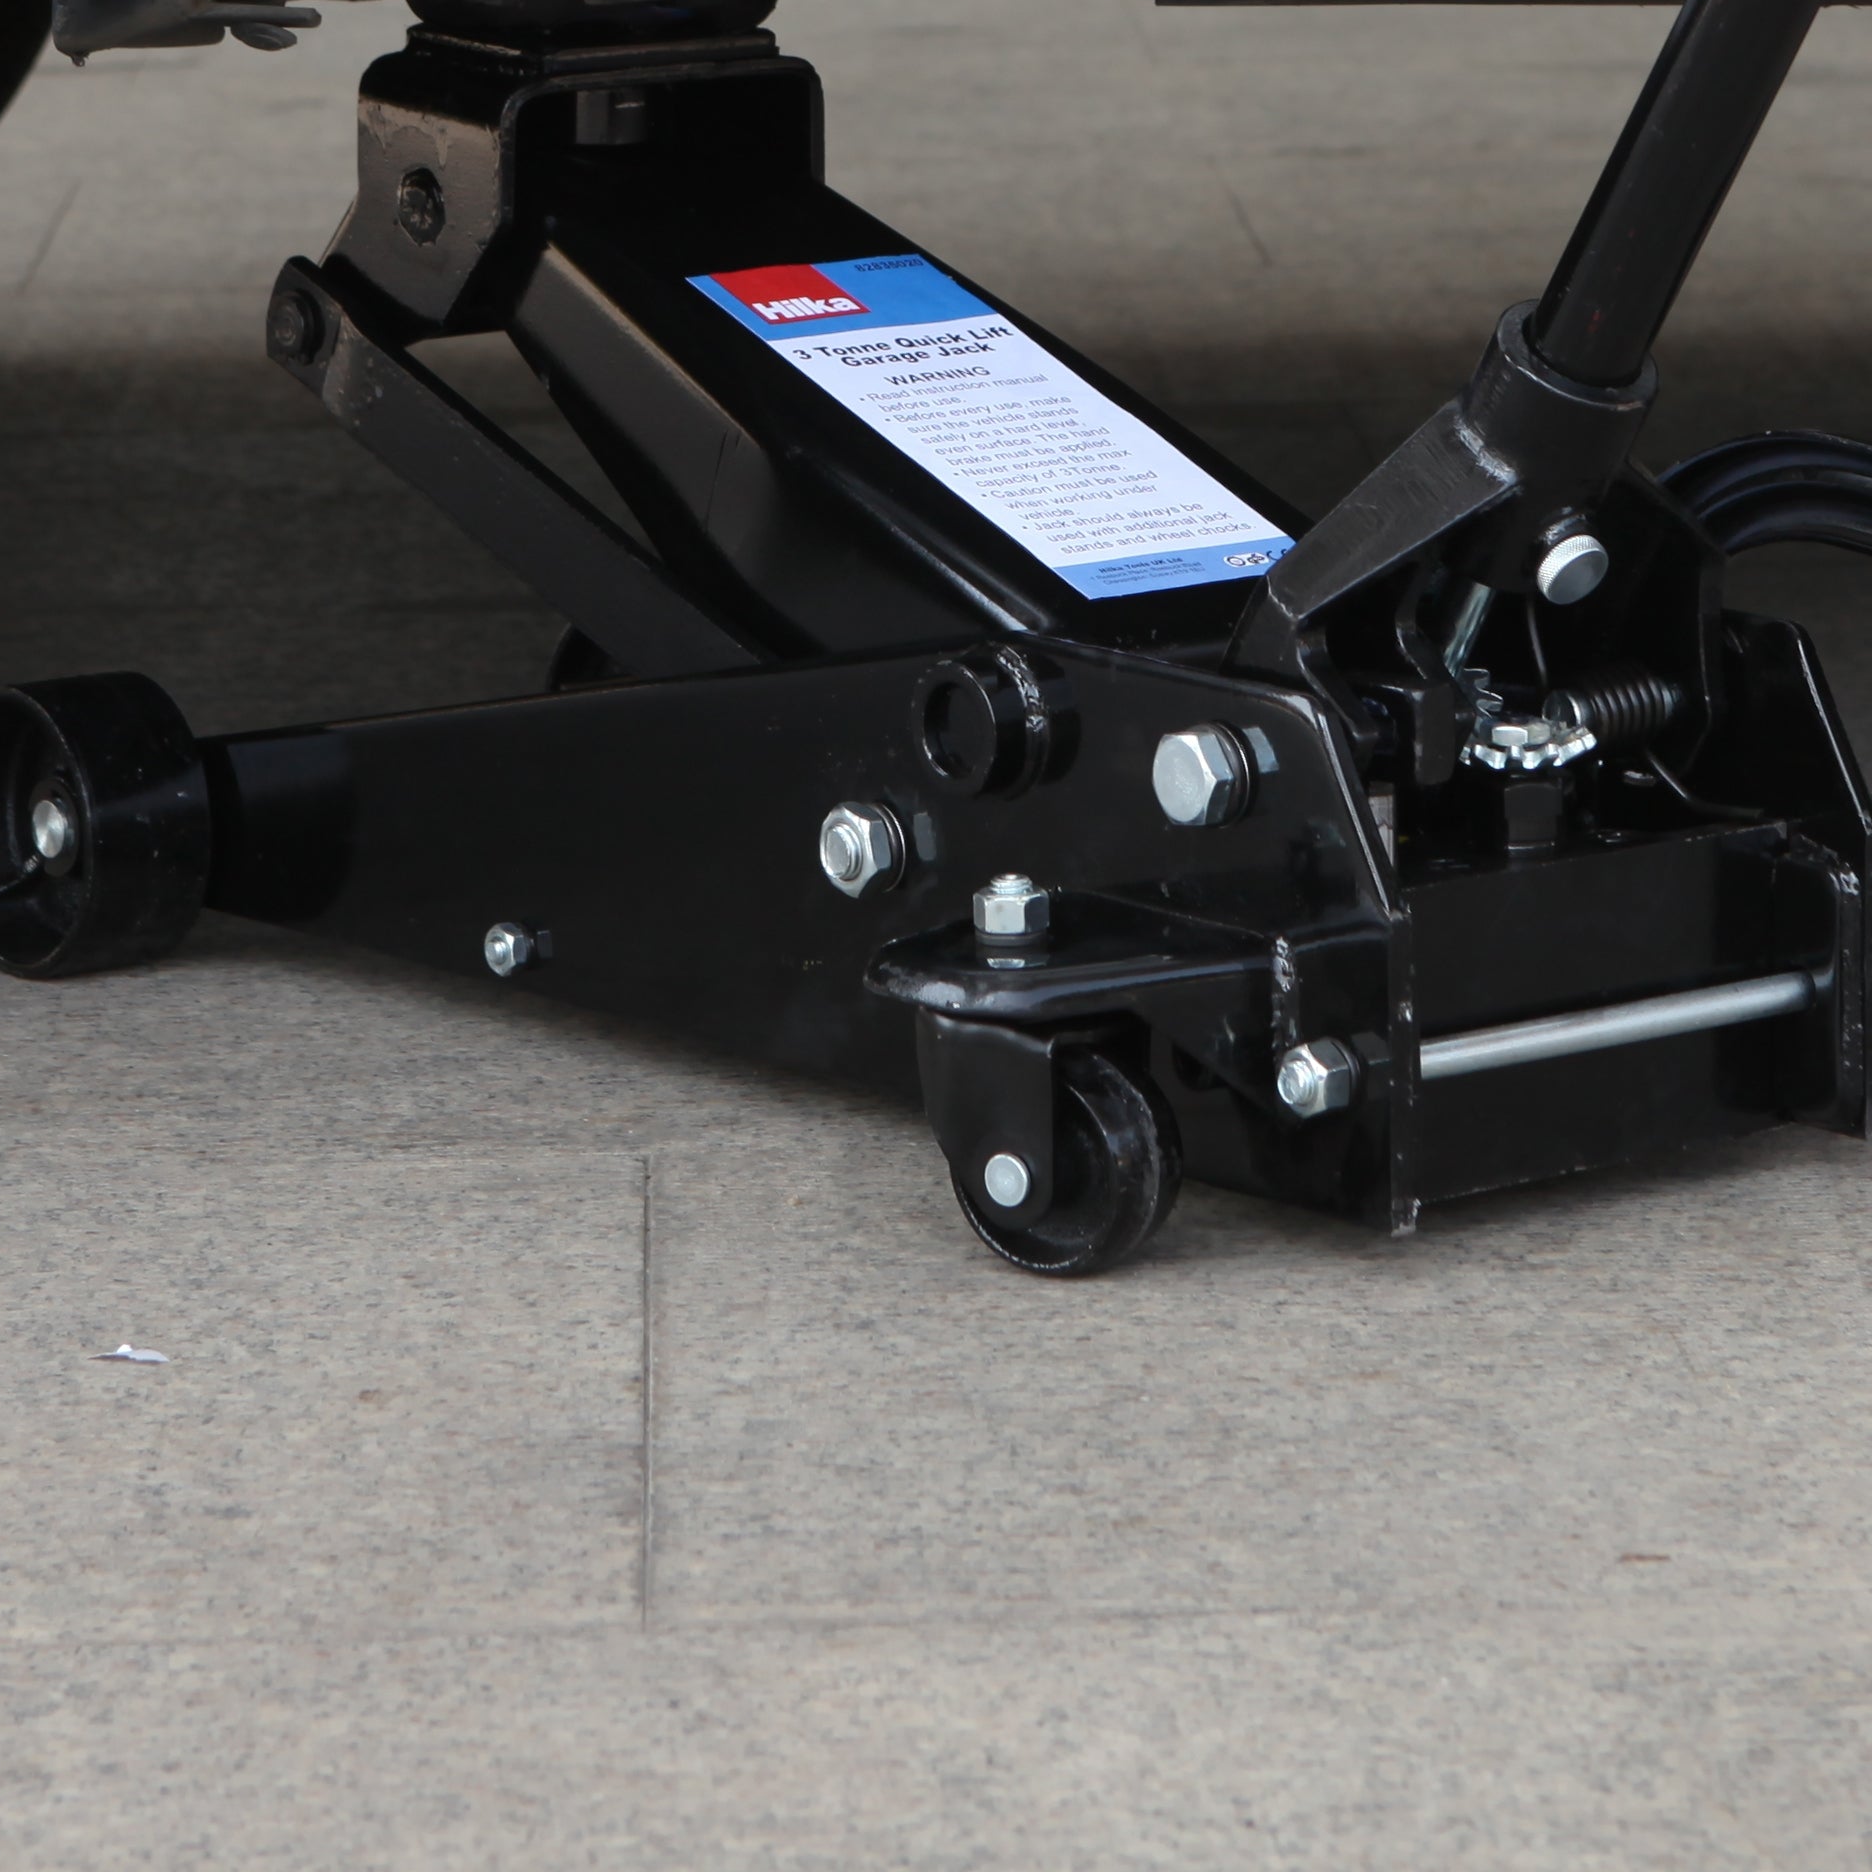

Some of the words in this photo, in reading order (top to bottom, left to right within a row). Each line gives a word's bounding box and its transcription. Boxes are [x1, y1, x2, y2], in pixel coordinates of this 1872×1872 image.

[751, 296, 861, 320] Hilka
[793, 349, 812, 359] 3
[812, 342, 891, 357] Tonne
[895, 333, 968, 348] Quick
[967, 327, 1014, 340] Lift
[841, 351, 930, 366] Garage
[938, 342, 996, 357] Jack
[866, 390, 911, 402] Read
[911, 381, 990, 396] instruction
[993, 373, 1048, 387] manual
[883, 366, 990, 386] WARNING
[878, 399, 930, 413] before
[932, 396, 966, 406] use.
[893, 411, 946, 423] Before
[949, 405, 992, 417] every
[1028, 396, 1072, 407] make
[907, 423, 942, 434] sure
[943, 420, 970, 429] the
[971, 413, 1026, 426] vehicle
[1028, 407, 1079, 420] stands
[921, 433, 966, 445] safely
[969, 430, 990, 439] on
[1003, 422, 1042, 435] hard
[935, 445, 973, 455] even
[975, 437, 1037, 450] surface.
[1035, 433, 1069, 442] The
[1068, 426, 1110, 438] hand
[945, 455, 992, 466] brake
[994, 449, 1033, 459] must
[1033, 447, 1056, 456] be
[1058, 438, 1116, 453] applied.
[960, 465, 1008, 477] Never
[1012, 456, 1068, 470] exceed
[1068, 454, 1095, 463] the
[1097, 449, 1132, 460] max
[975, 473, 1039, 488] capacity
[1041, 470, 1058, 479] of
[990, 486, 1052, 498] Caution
[1054, 478, 1094, 491] must
[1093, 477, 1117, 485] be
[1118, 470, 1158, 482] used
[1007, 499, 1050, 510] when
[1050, 489, 1113, 505] working
[1113, 484, 1158, 496] under
[1035, 520, 1070, 530] Jack
[1072, 512, 1124, 526] should
[1127, 507, 1180, 519] always
[1180, 503, 1204, 512] be
[1046, 531, 1086, 542] used
[1087, 526, 1121, 537] with
[1123, 515, 1198, 532] additional
[1200, 511, 1232, 523] jack
[1061, 540, 1114, 554] stands
[1116, 534, 1146, 546] and
[1148, 528, 1196, 542] wheel
